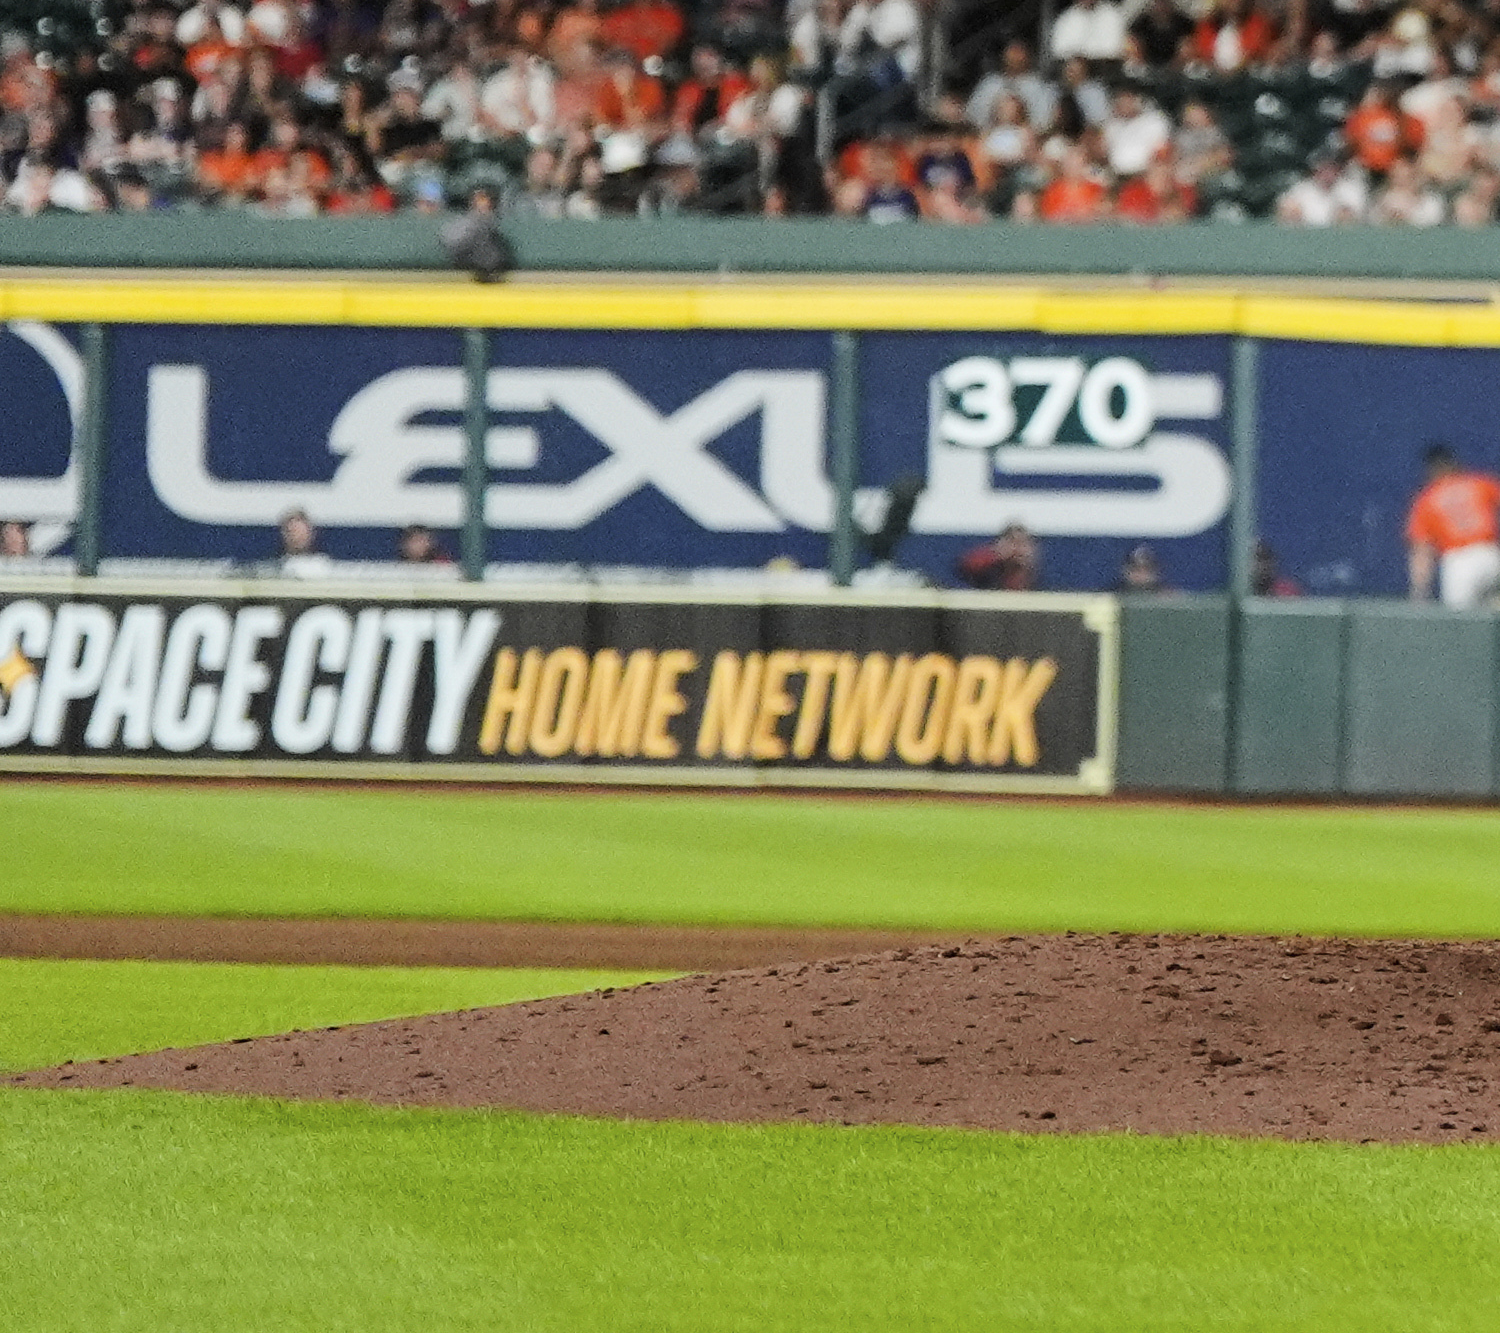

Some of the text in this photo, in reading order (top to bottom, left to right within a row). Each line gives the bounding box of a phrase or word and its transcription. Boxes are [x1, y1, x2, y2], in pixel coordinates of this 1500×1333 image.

[938, 354, 1156, 451] 370
[0, 598, 1060, 769] SPACE CITY HOME NETWORK
